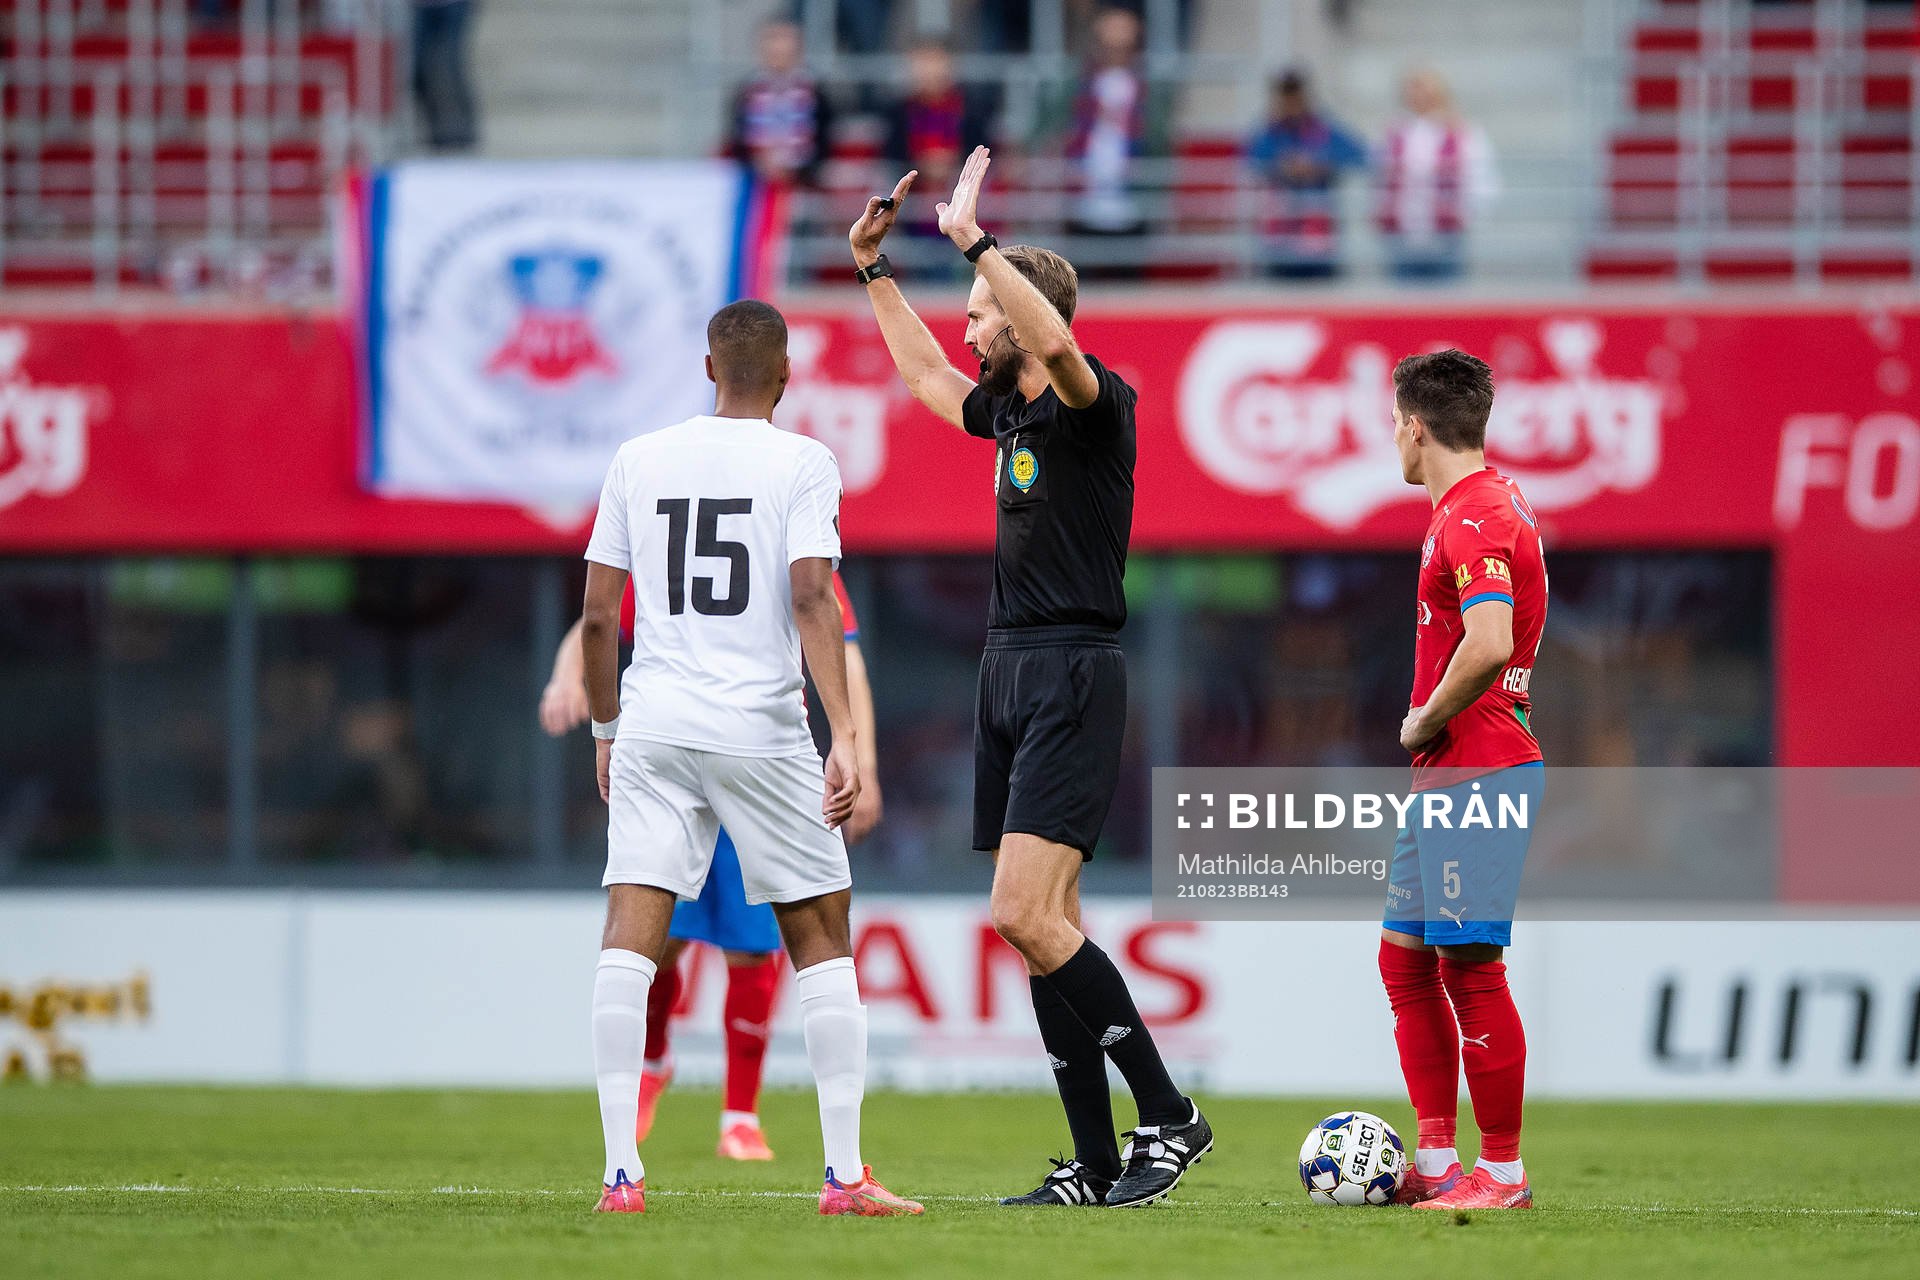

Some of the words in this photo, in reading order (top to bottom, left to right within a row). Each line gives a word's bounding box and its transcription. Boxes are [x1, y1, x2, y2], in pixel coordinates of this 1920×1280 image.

[1178, 320, 1662, 522] Carlerg
[656, 498, 753, 615] 15
[1443, 860, 1461, 899] 5
[1351, 1123, 1376, 1177] SELECT
